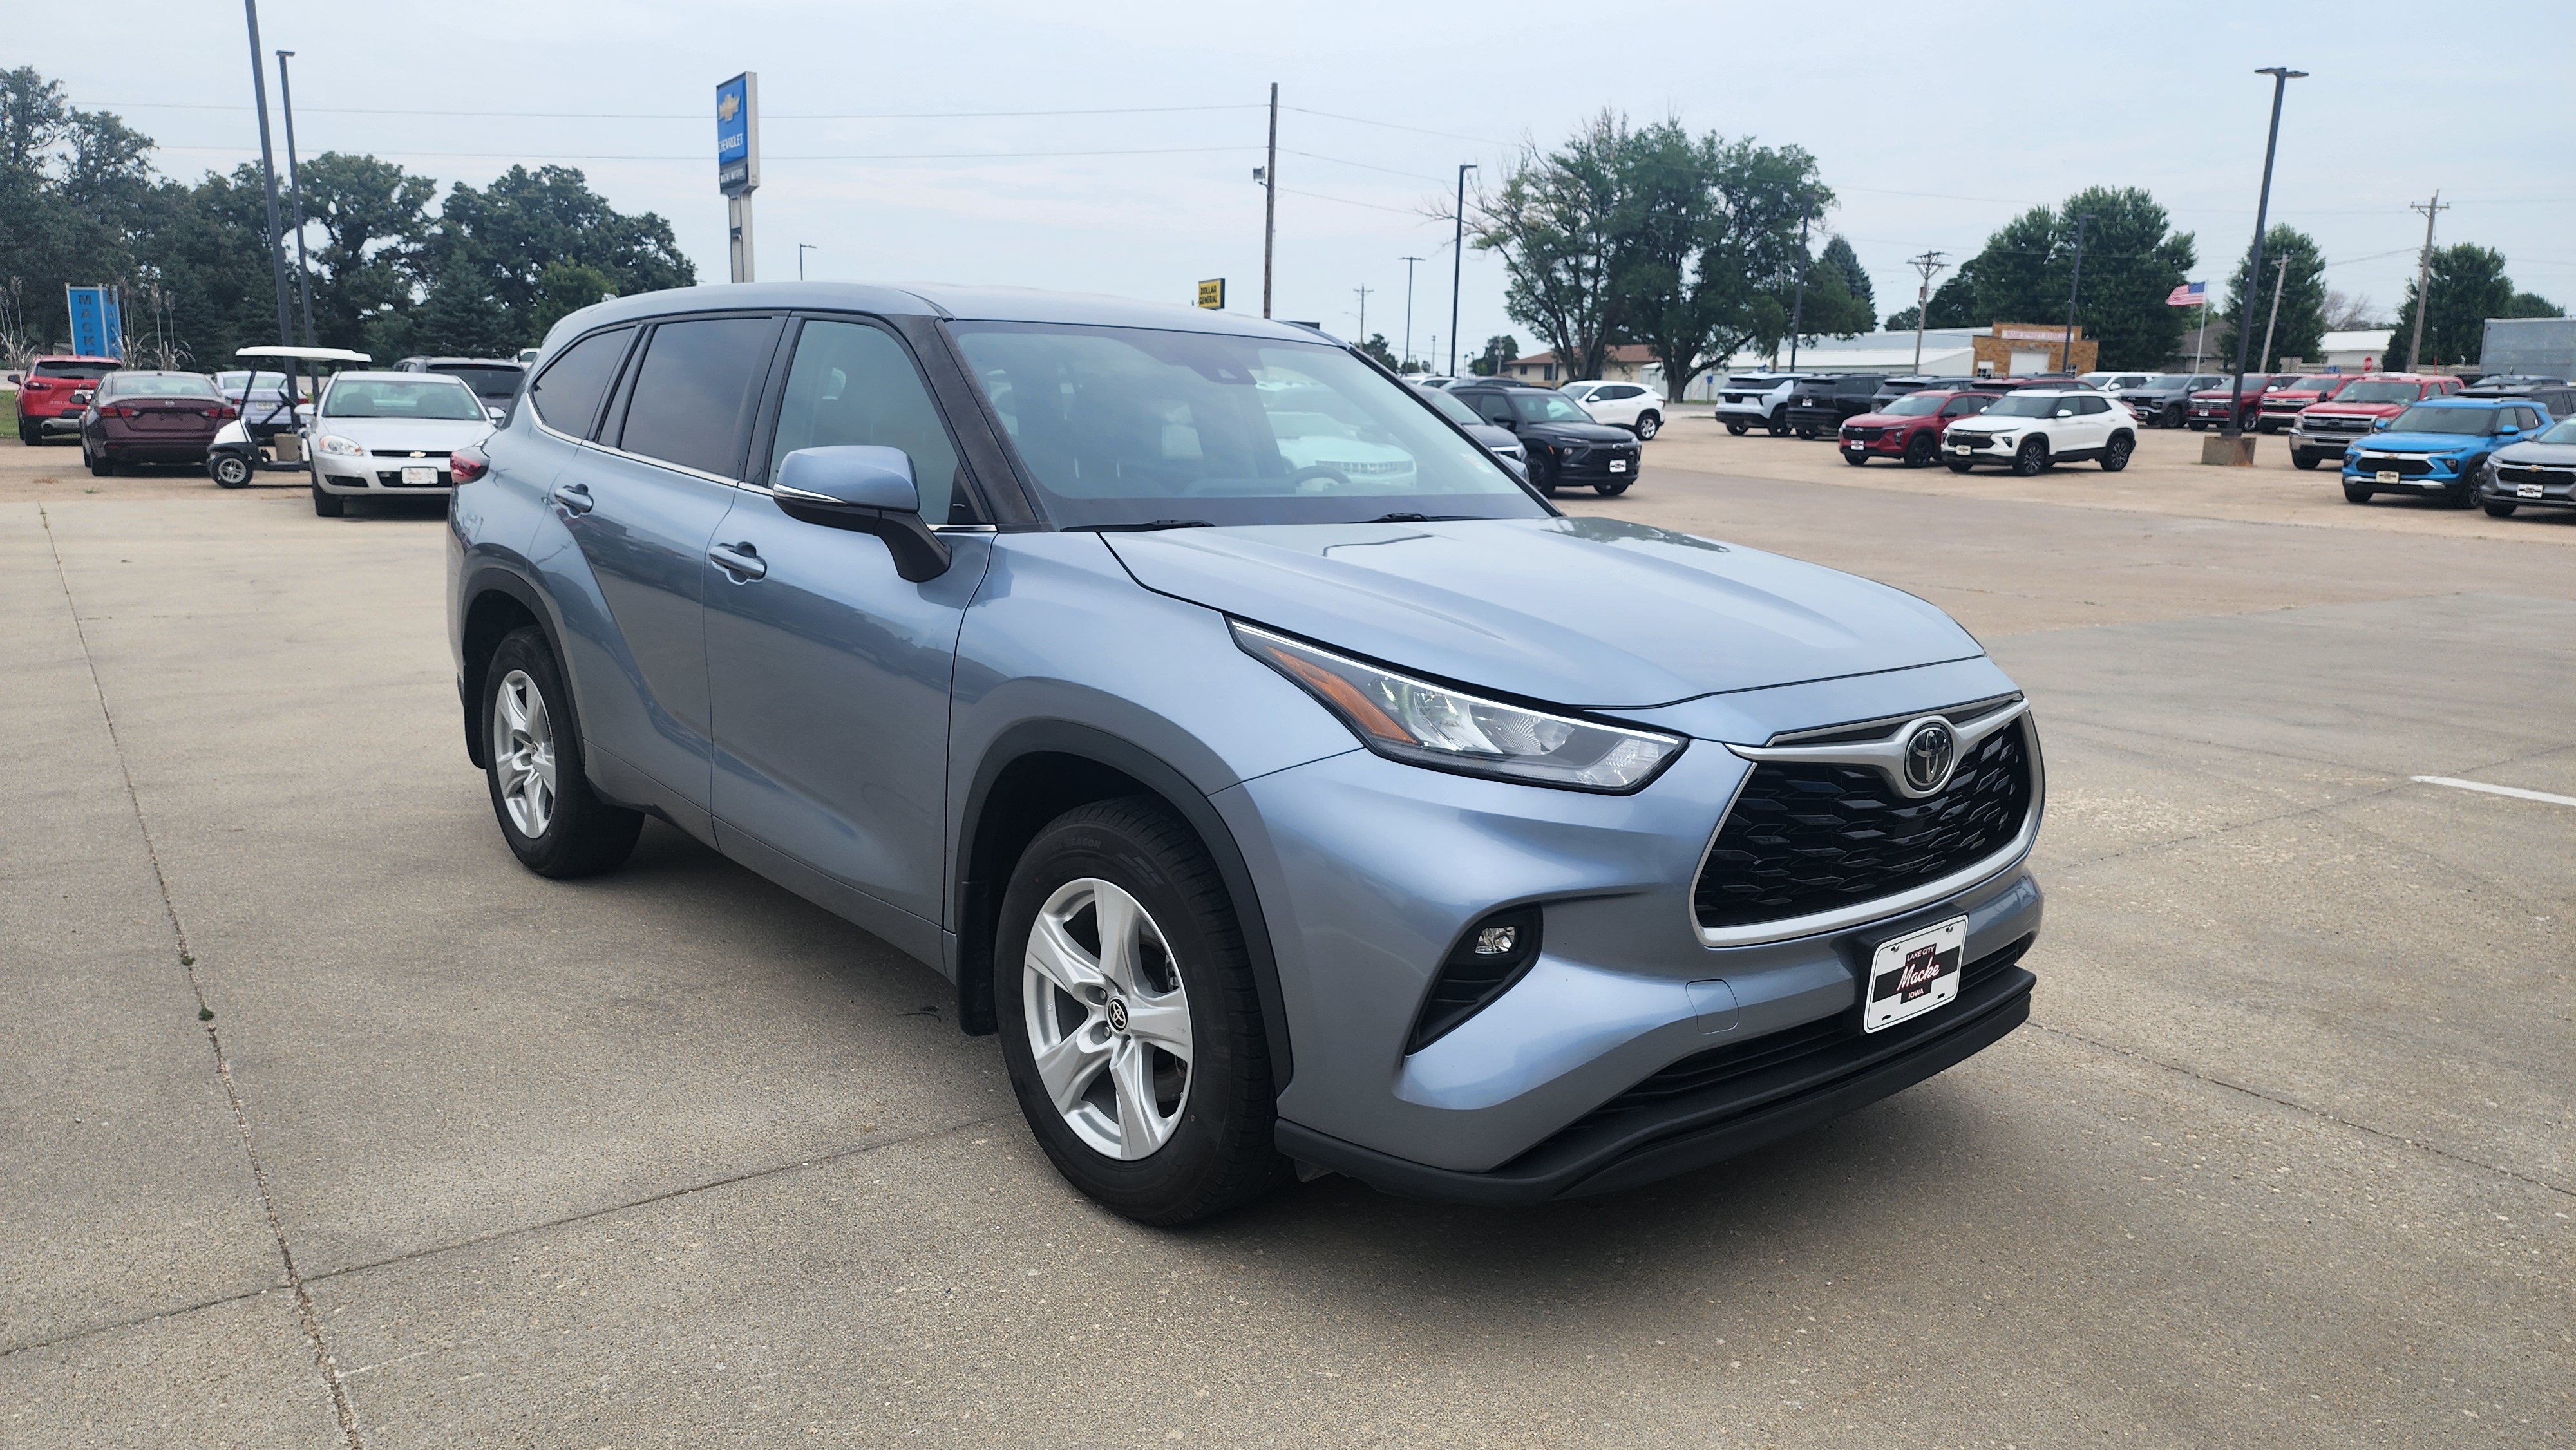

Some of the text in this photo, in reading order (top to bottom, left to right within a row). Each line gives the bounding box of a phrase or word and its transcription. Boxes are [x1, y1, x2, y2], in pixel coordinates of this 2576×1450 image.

[719, 133, 743, 153] CHEVROLET
[1200, 285, 1217, 295] DOLLAR
[1198, 295, 1218, 305] GENERAL
[1907, 945, 1935, 961] LAKE CITY
[1896, 956, 1940, 992] Macke
[1908, 988, 1924, 1000] IOWA
